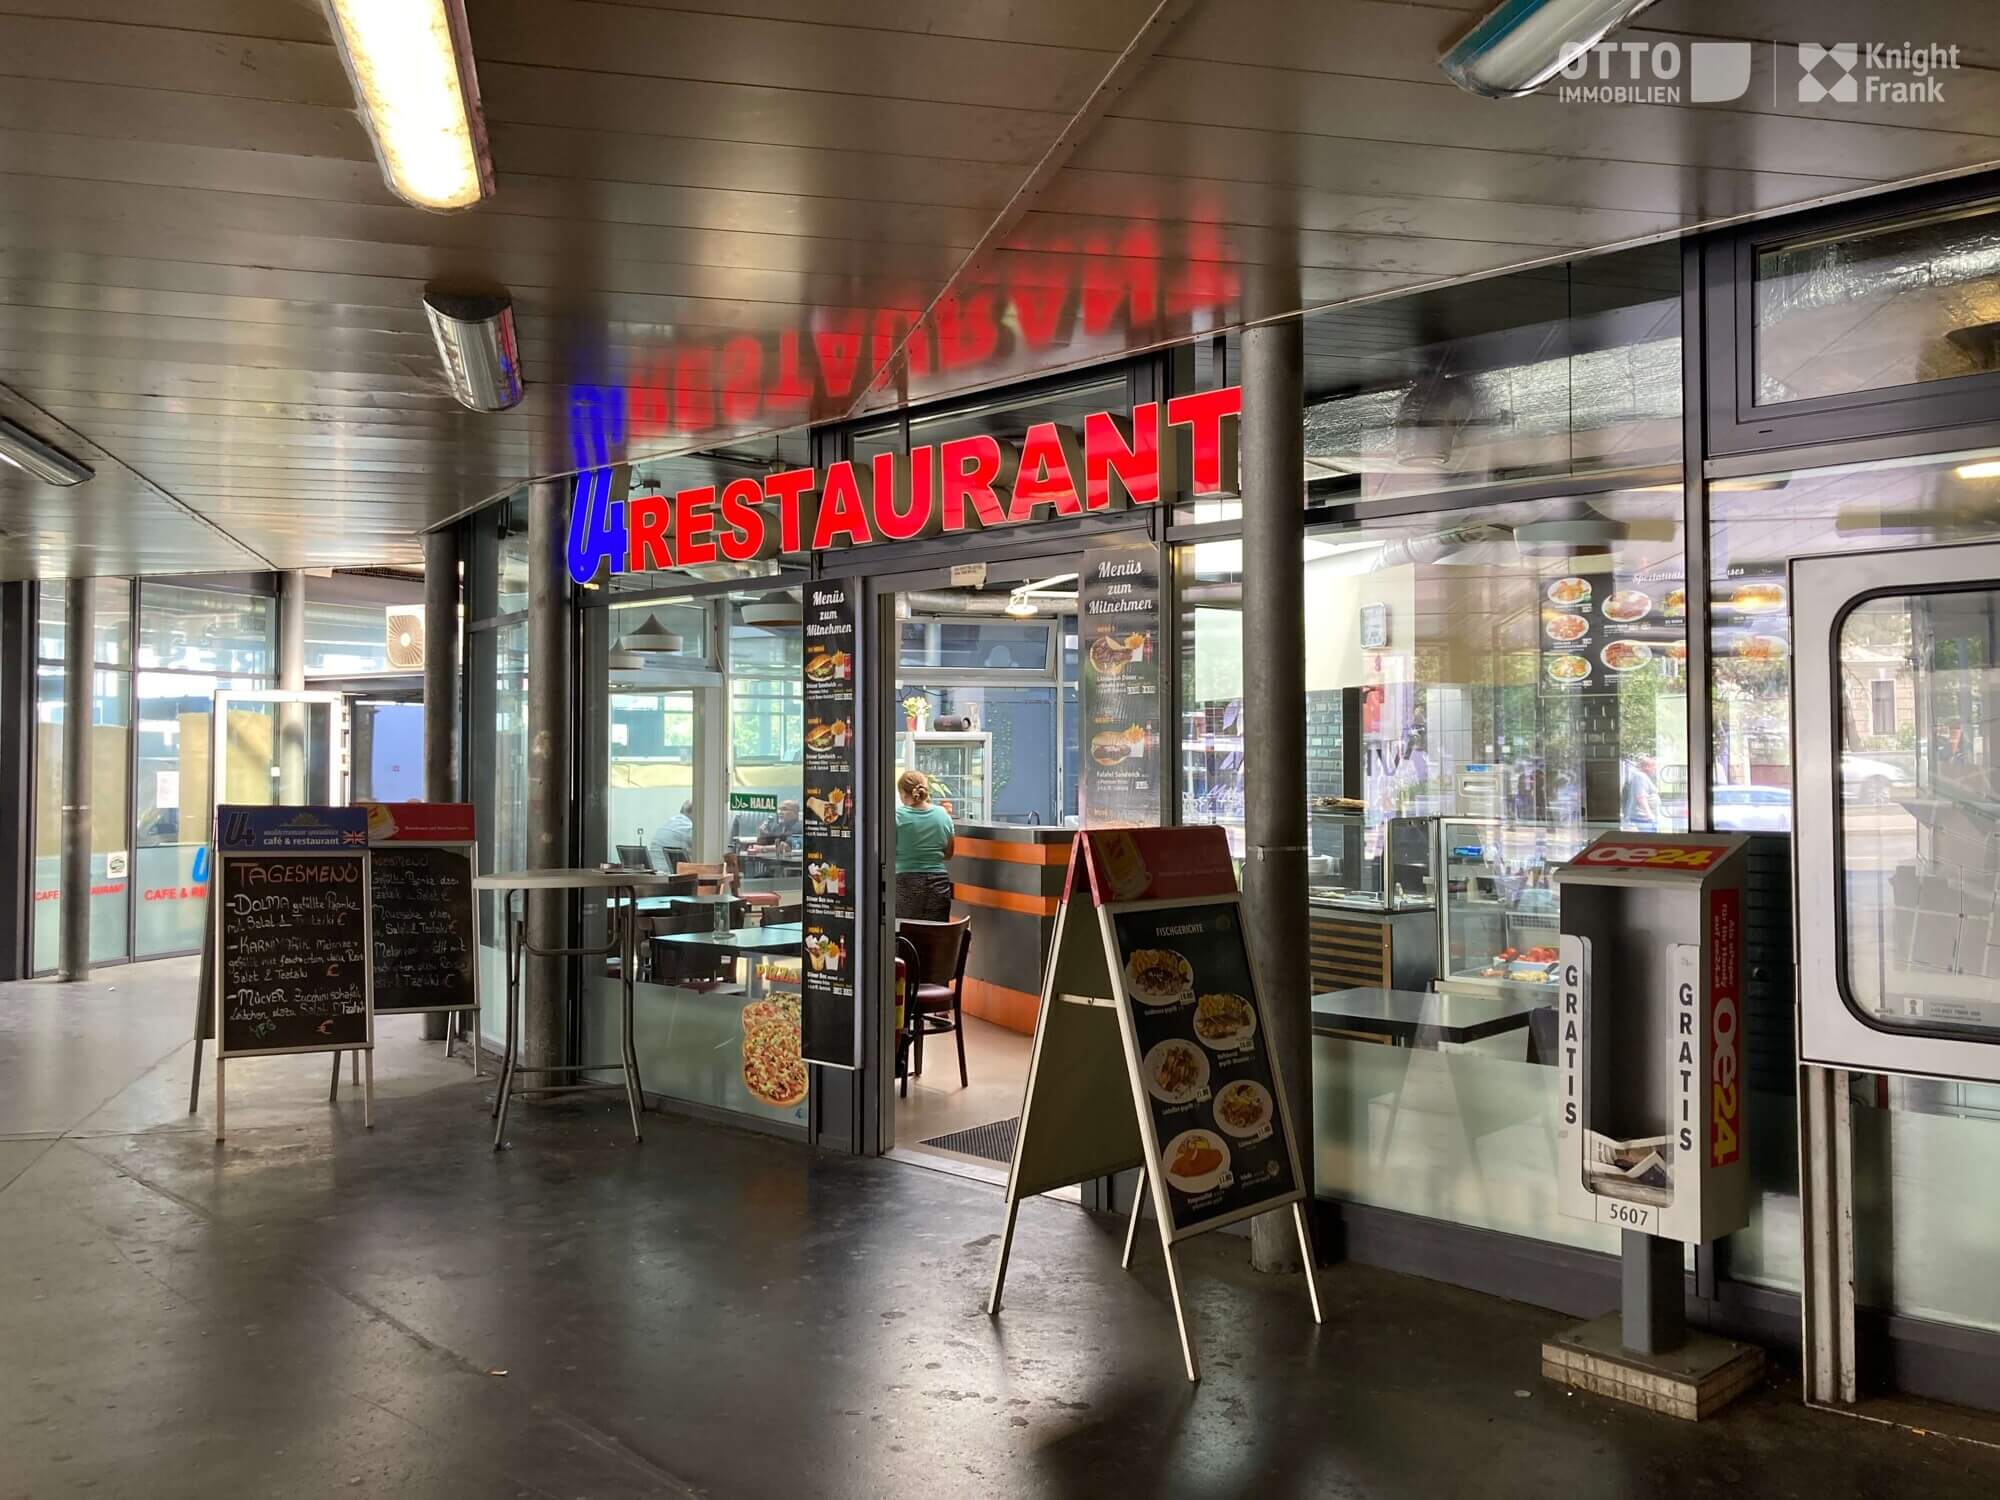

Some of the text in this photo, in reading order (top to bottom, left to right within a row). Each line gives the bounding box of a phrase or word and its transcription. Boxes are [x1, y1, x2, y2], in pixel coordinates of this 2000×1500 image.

[567, 385, 1242, 584] U4 RESTAURANT
[1098, 560, 1142, 578] Menüs
[1108, 583, 1132, 595] zum
[812, 591, 845, 606] Menüs
[1089, 599, 1152, 615] Mitnehmen
[819, 610, 838, 621] zum
[806, 623, 852, 637] Mitnehmen
[750, 797, 776, 810] HALAL
[293, 836, 339, 845] restaurant
[144, 888, 177, 901] CAFE
[180, 887, 188, 899] &
[1156, 923, 1204, 937] FISCHGERICHTE
[1565, 965, 1578, 1124] GRATIS
[1679, 983, 1693, 1151] GRATIS
[1610, 1203, 1648, 1226] 5607
